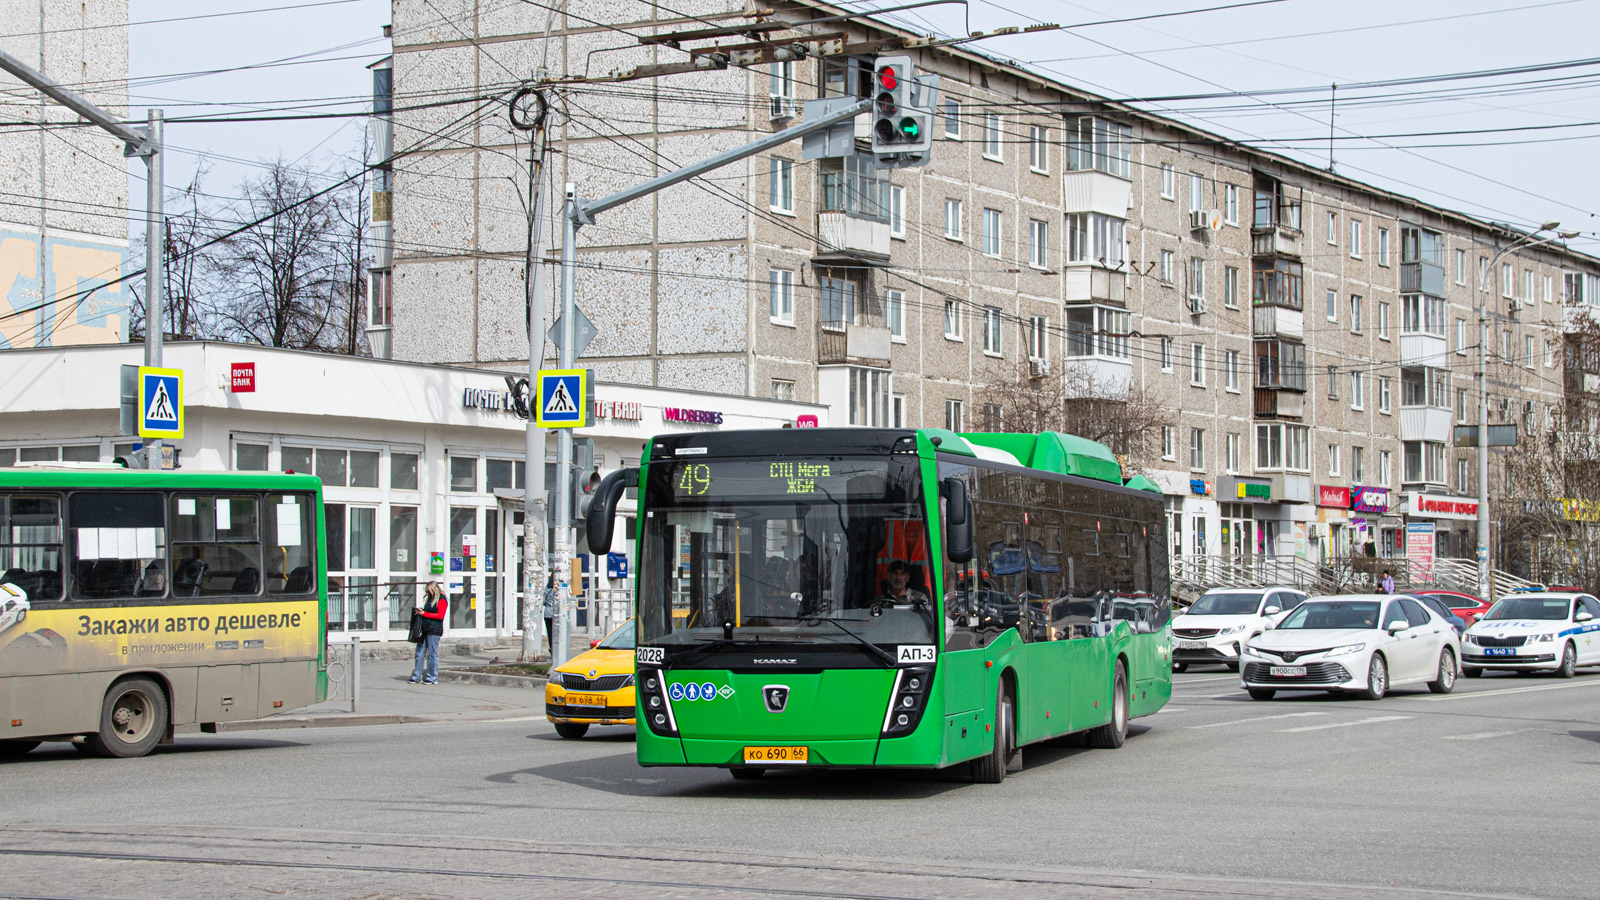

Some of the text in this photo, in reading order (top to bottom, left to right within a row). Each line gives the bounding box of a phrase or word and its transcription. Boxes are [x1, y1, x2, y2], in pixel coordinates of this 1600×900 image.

[232, 368, 254, 377] ПОЧТА
[233, 378, 251, 386] БАНК
[464, 387, 502, 410] ПОЧТА
[664, 406, 723, 424] WILDBERRIES
[798, 420, 815, 428] WB
[769, 463, 830, 478] СТЦ Мега
[679, 464, 710, 495] 49
[787, 478, 815, 493] ЖБИ
[77, 614, 160, 637] Закажи
[164, 616, 210, 633] авто
[1481, 621, 1539, 629] ДПС
[121, 646, 128, 655] в
[131, 642, 205, 656] приложении
[638, 648, 662, 662] 2028
[901, 648, 934, 660] АП-3
[579, 696, 593, 704] 678
[767, 748, 787, 760] 690
[793, 747, 804, 756] 66
